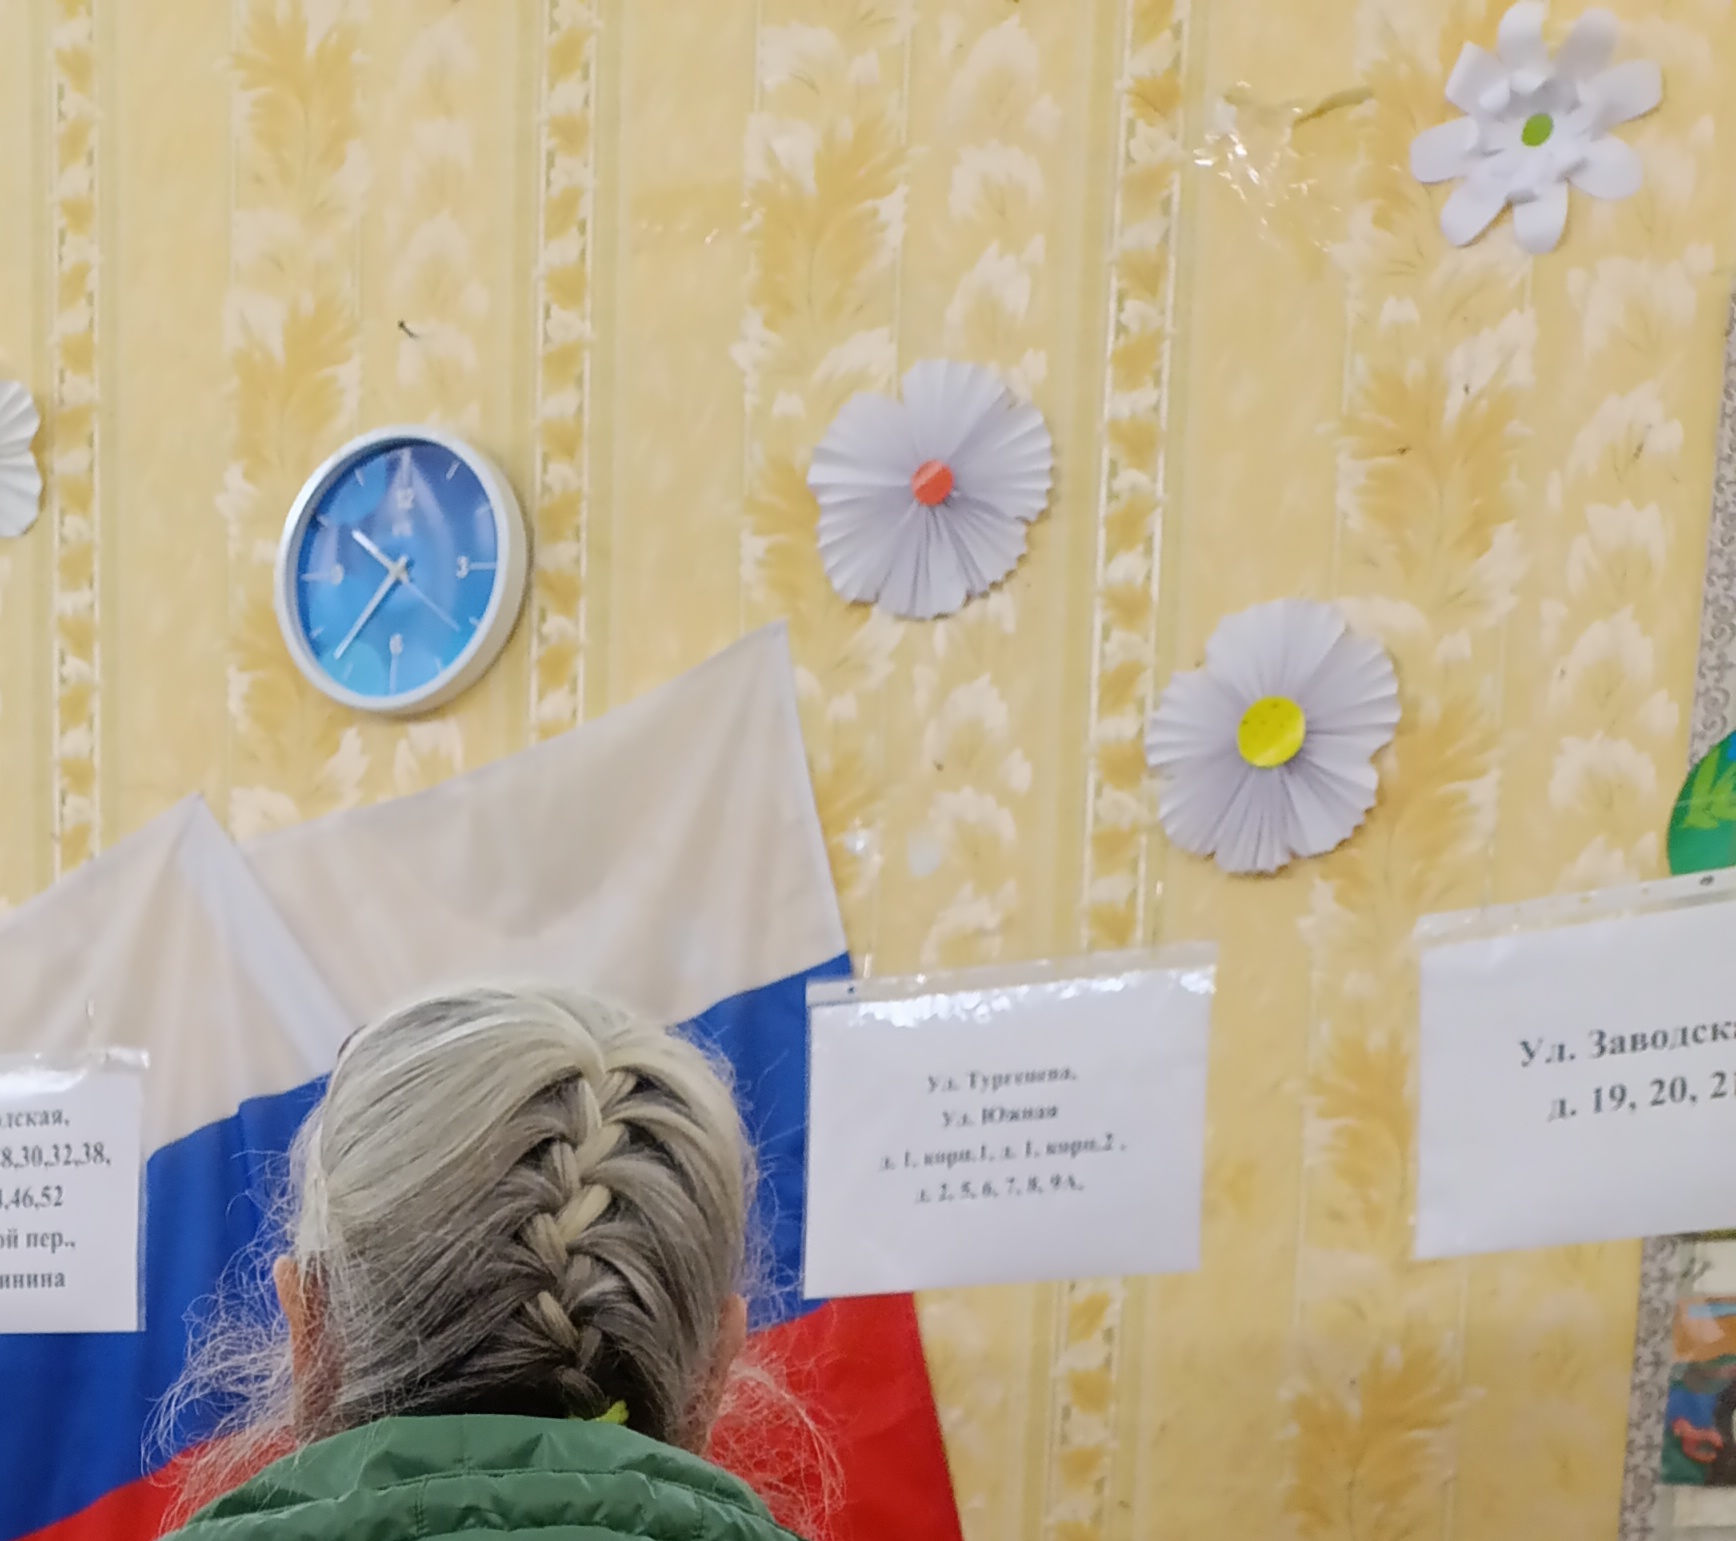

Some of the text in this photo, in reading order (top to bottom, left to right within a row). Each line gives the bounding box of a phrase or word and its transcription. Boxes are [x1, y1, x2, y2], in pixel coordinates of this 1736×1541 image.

[1519, 1036, 1576, 1067] Ул.
[1546, 1098, 1577, 1123] д.
[1592, 1083, 1637, 1115] 19,
[1649, 1075, 1698, 1107] 20,
[941, 1105, 1058, 1128] Ул. Южная
